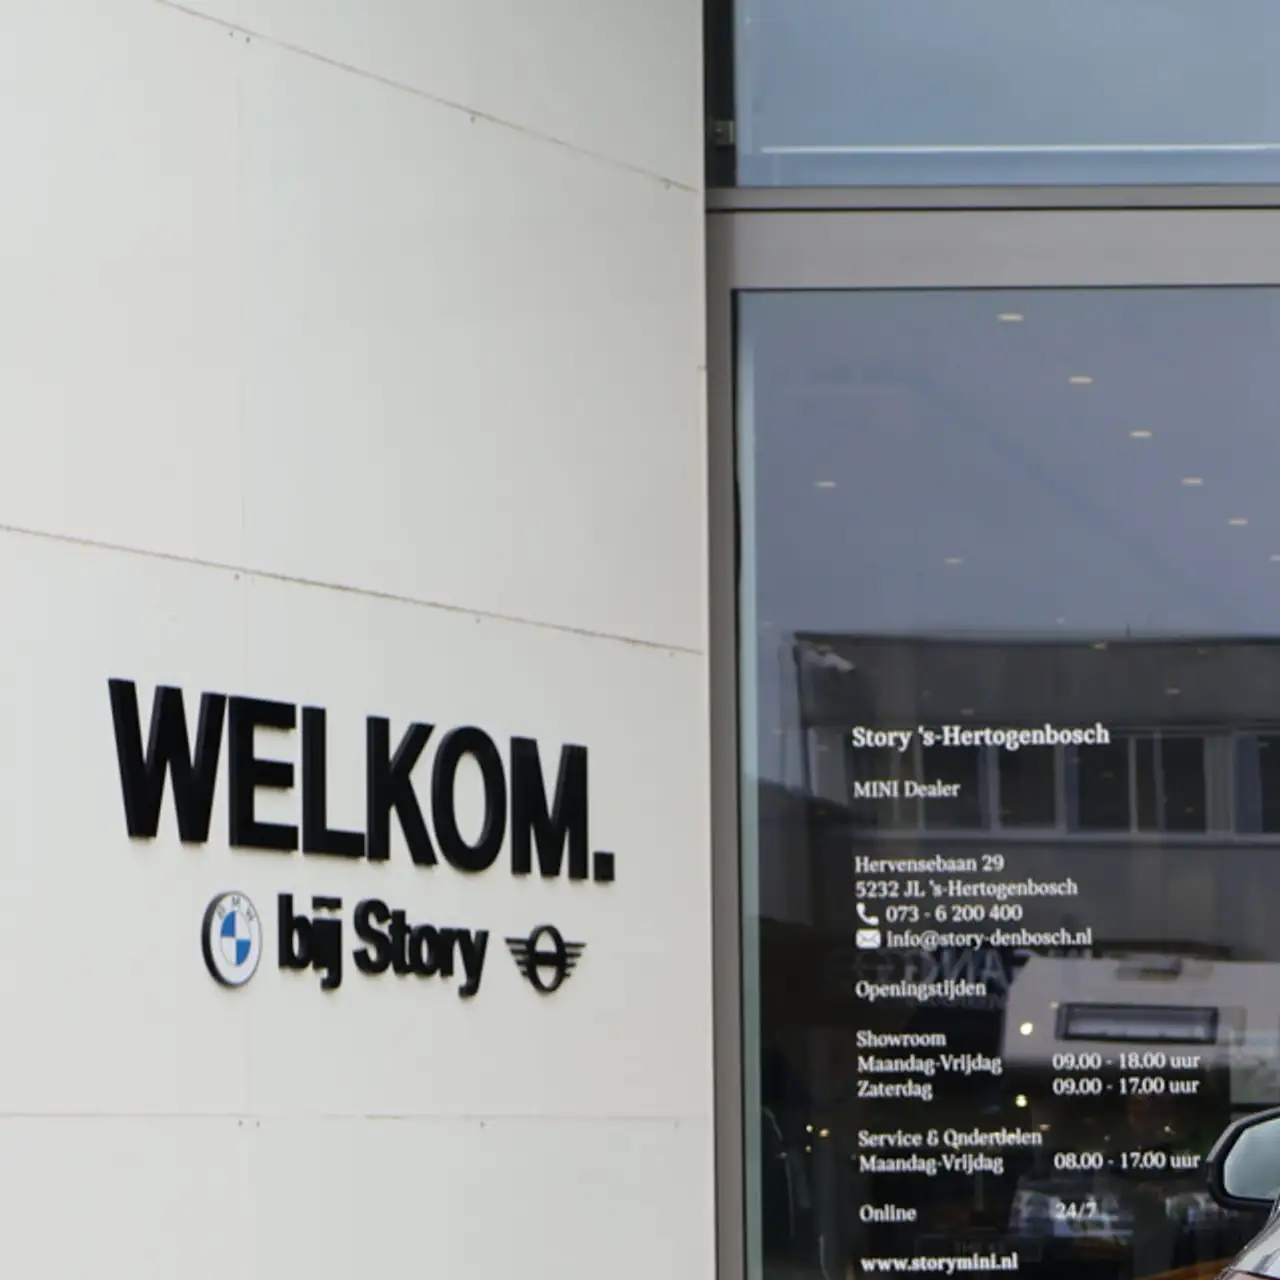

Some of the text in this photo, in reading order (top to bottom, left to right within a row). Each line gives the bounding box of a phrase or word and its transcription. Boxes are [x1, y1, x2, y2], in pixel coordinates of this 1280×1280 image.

[852, 722, 1110, 752] Story 's-Hertogenbosch
[107, 678, 616, 882] WELKOM.
[854, 780, 961, 799] MINI Dealer
[854, 855, 1004, 873] Hervensebaan 29
[855, 878, 1078, 899] 5232 JL 's-Hertogenbosch
[886, 905, 919, 922] 073
[935, 905, 947, 922] 6
[952, 905, 985, 922] 200
[989, 904, 1023, 922] 400
[278, 893, 488, 997] bij Story
[887, 929, 1093, 951] info@story-denbosch.nl
[855, 979, 986, 1000] Openingstijden
[857, 1031, 947, 1048] Showroom
[857, 1055, 1002, 1076] Maandag-Vrijdag
[1052, 1053, 1101, 1071] 09.00
[1119, 1053, 1166, 1070] 18.00
[1169, 1055, 1200, 1069] uur
[857, 1081, 933, 1100] Zaterdag
[1053, 1078, 1102, 1095] 09.00
[1119, 1078, 1165, 1094] 17.00
[1169, 1080, 1200, 1094] uur
[858, 1130, 1042, 1149] Service & Onderdelen
[859, 1154, 1003, 1175] Maandag-Vrijdag
[1054, 1153, 1104, 1170] 08.00
[1120, 1153, 1166, 1169] 17.00
[1170, 1155, 1200, 1169] uur
[859, 1203, 1097, 1222] Online 24/7
[861, 1254, 1018, 1275] www.storymini.nl
